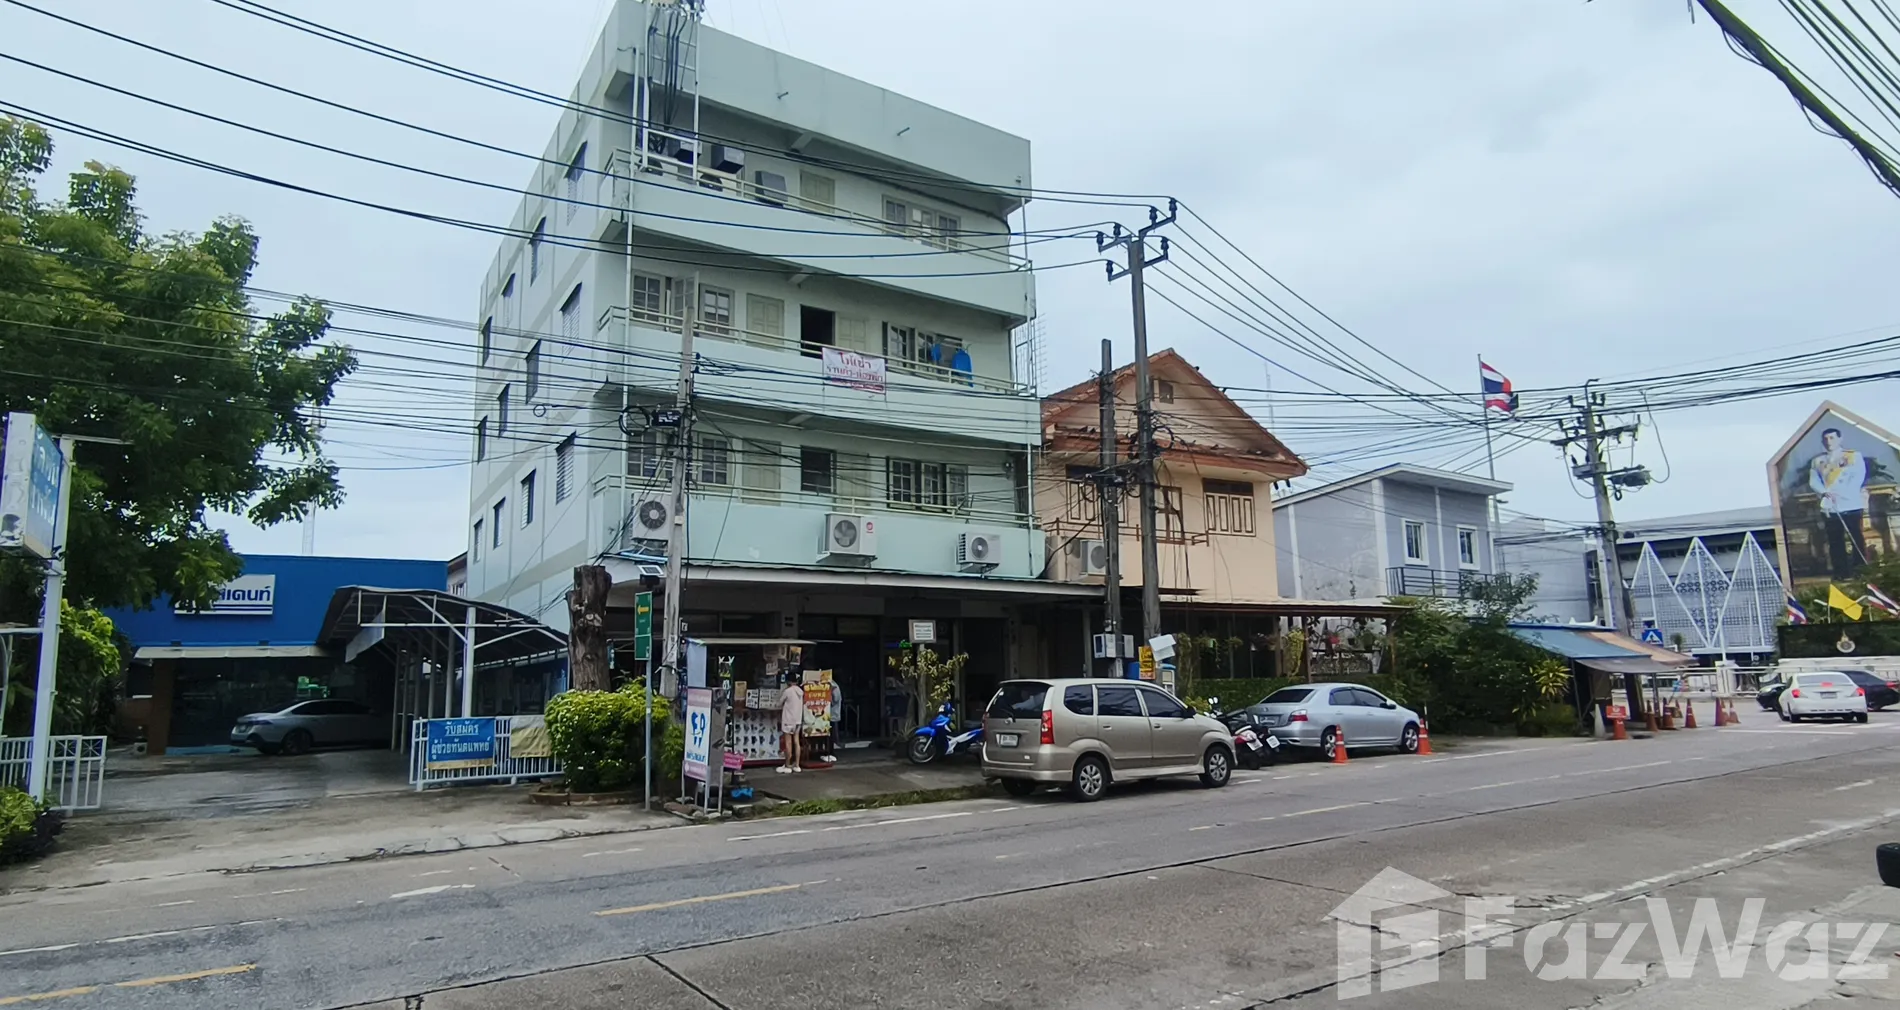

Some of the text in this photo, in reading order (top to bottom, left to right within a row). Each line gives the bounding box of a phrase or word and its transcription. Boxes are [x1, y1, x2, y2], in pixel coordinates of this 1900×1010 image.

[445, 720, 479, 735] รับสมัคร
[431, 736, 491, 760] ผู้ช่วยทันตแพทย์
